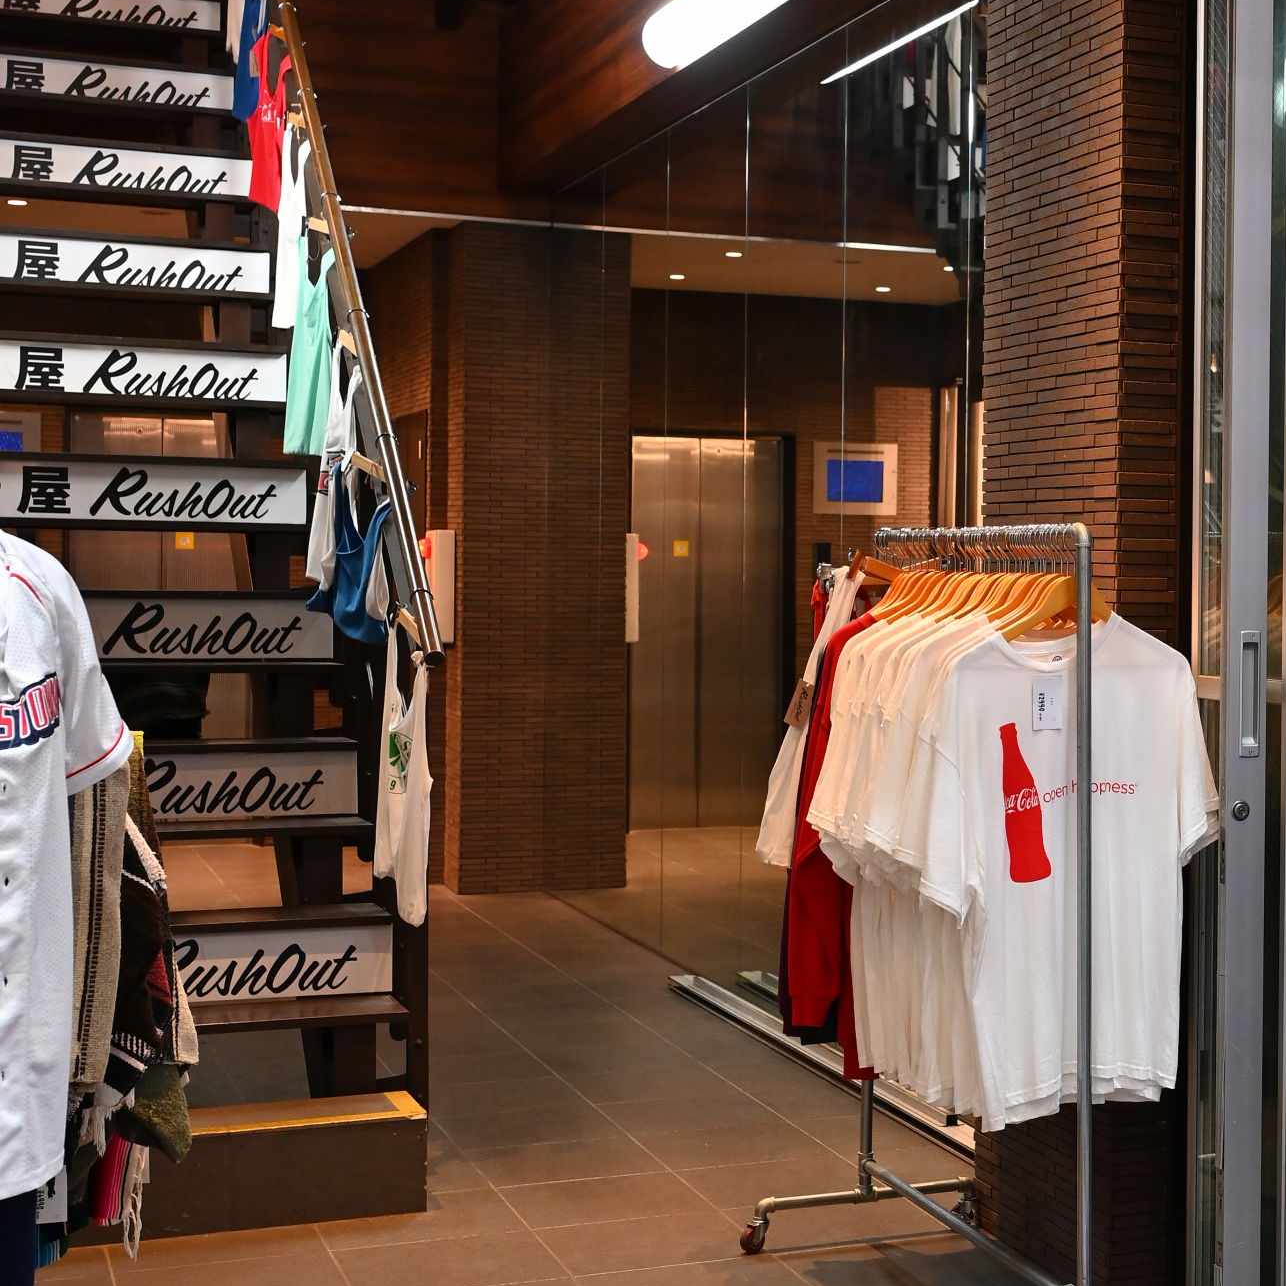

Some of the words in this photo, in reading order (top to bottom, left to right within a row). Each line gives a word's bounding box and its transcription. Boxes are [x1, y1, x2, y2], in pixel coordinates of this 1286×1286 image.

[13, 240, 60, 280] 屋
[15, 346, 65, 391] 屋
[83, 349, 260, 401] RushOut
[17, 466, 72, 514] 屋
[89, 467, 278, 519] RushOut
[102, 602, 303, 656] RushOut
[1043, 785, 1068, 804] open
